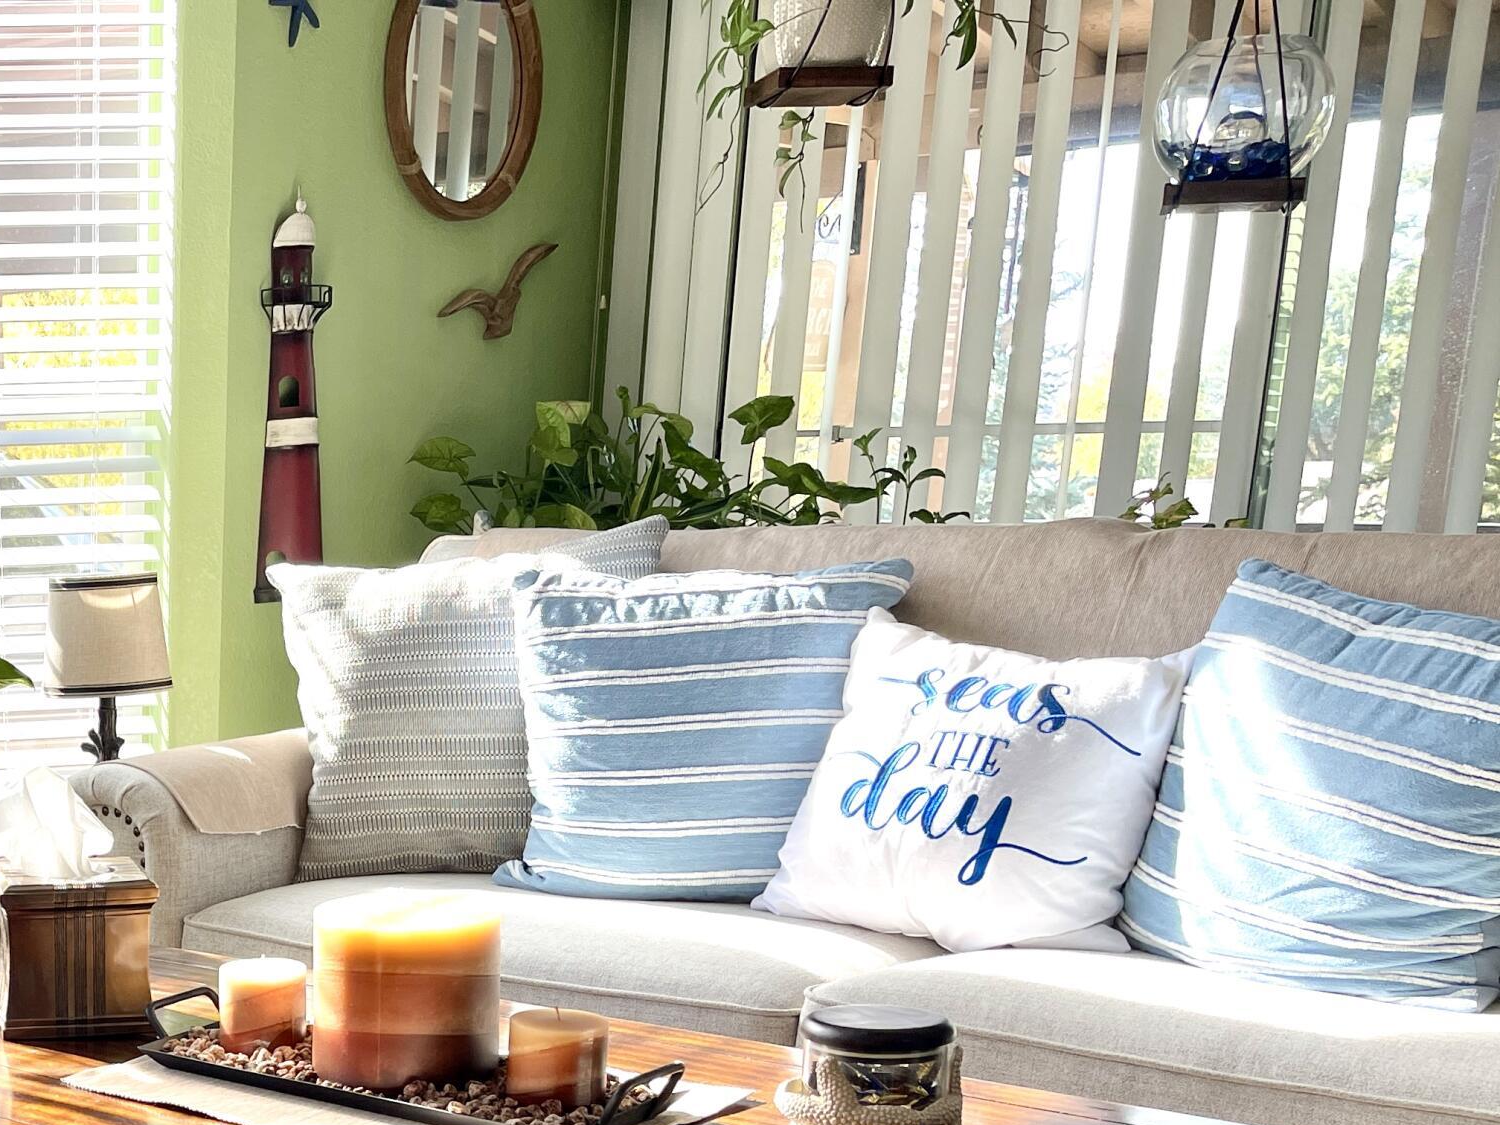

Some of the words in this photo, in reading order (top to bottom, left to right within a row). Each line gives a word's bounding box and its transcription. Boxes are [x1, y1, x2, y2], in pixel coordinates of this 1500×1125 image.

[879, 667, 1142, 756] seas
[925, 730, 1010, 777] THE
[826, 740, 1088, 886] day
